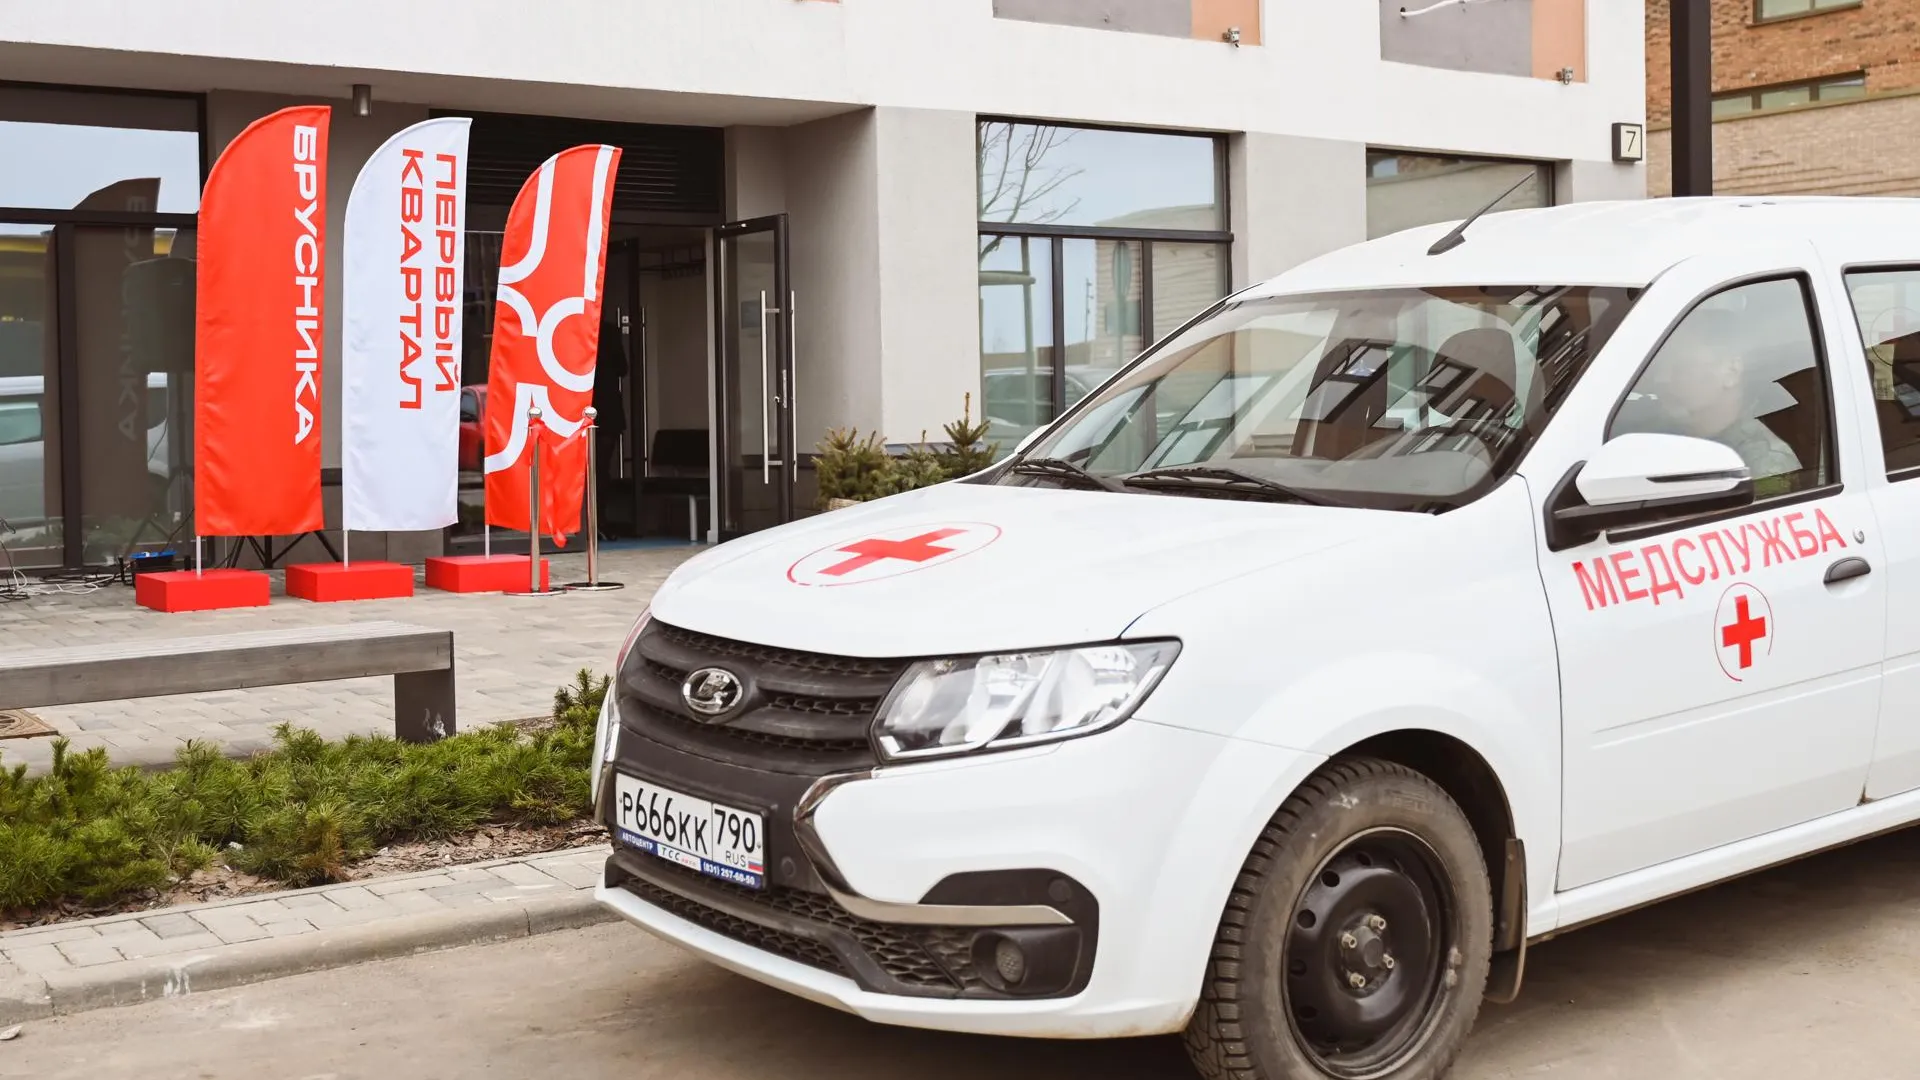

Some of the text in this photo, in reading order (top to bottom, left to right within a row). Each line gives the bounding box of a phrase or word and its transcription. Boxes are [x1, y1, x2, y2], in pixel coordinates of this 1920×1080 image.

[1625, 130, 1636, 152] 7
[293, 124, 319, 446] БРУСНИКА
[399, 148, 424, 410] КВАРТАЛ
[435, 153, 460, 392] ПЕРВЫЙ
[1571, 507, 1848, 611] МЕДСЛУЖБА
[714, 808, 756, 853] 790
[725, 850, 747, 868] RUS
